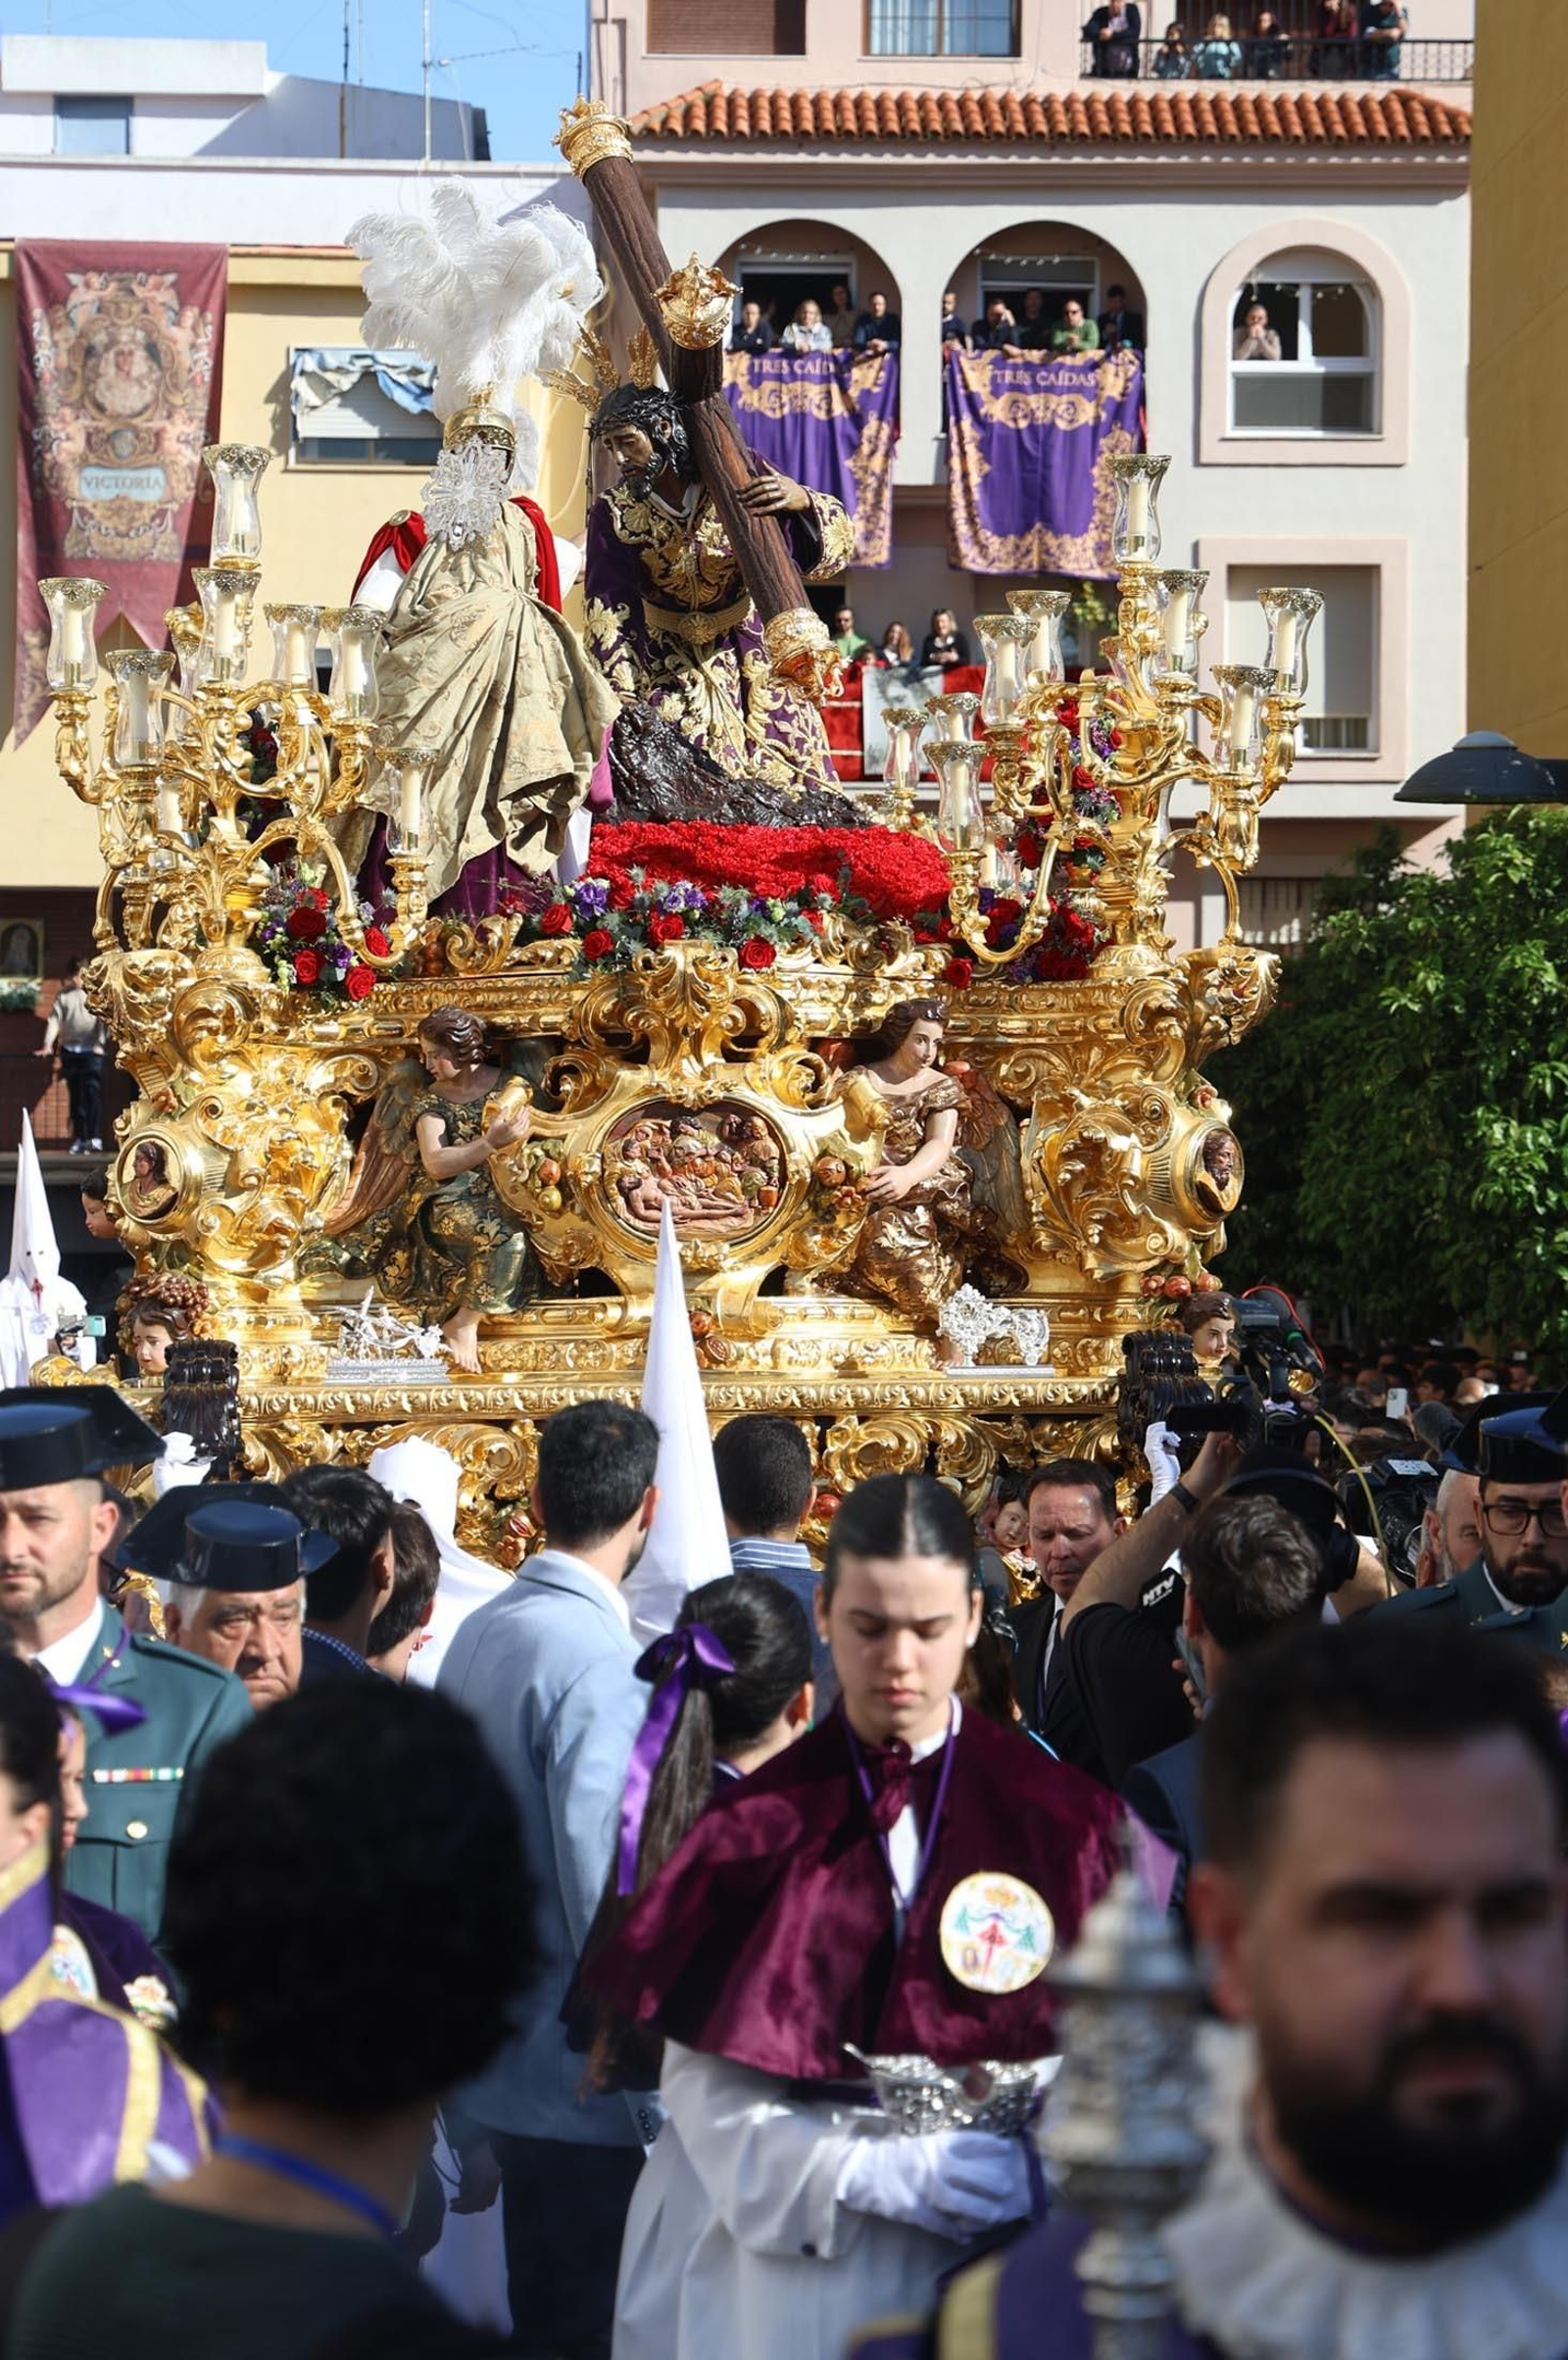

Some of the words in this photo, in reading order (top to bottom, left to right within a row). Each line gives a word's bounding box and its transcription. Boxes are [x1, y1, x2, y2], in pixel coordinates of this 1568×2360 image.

[752, 359, 790, 374] TRES
[793, 358, 836, 375] CAÍD
[993, 369, 1032, 385] TRES
[1036, 369, 1097, 387] CAÍDAS
[83, 474, 164, 489] VICTORIA
